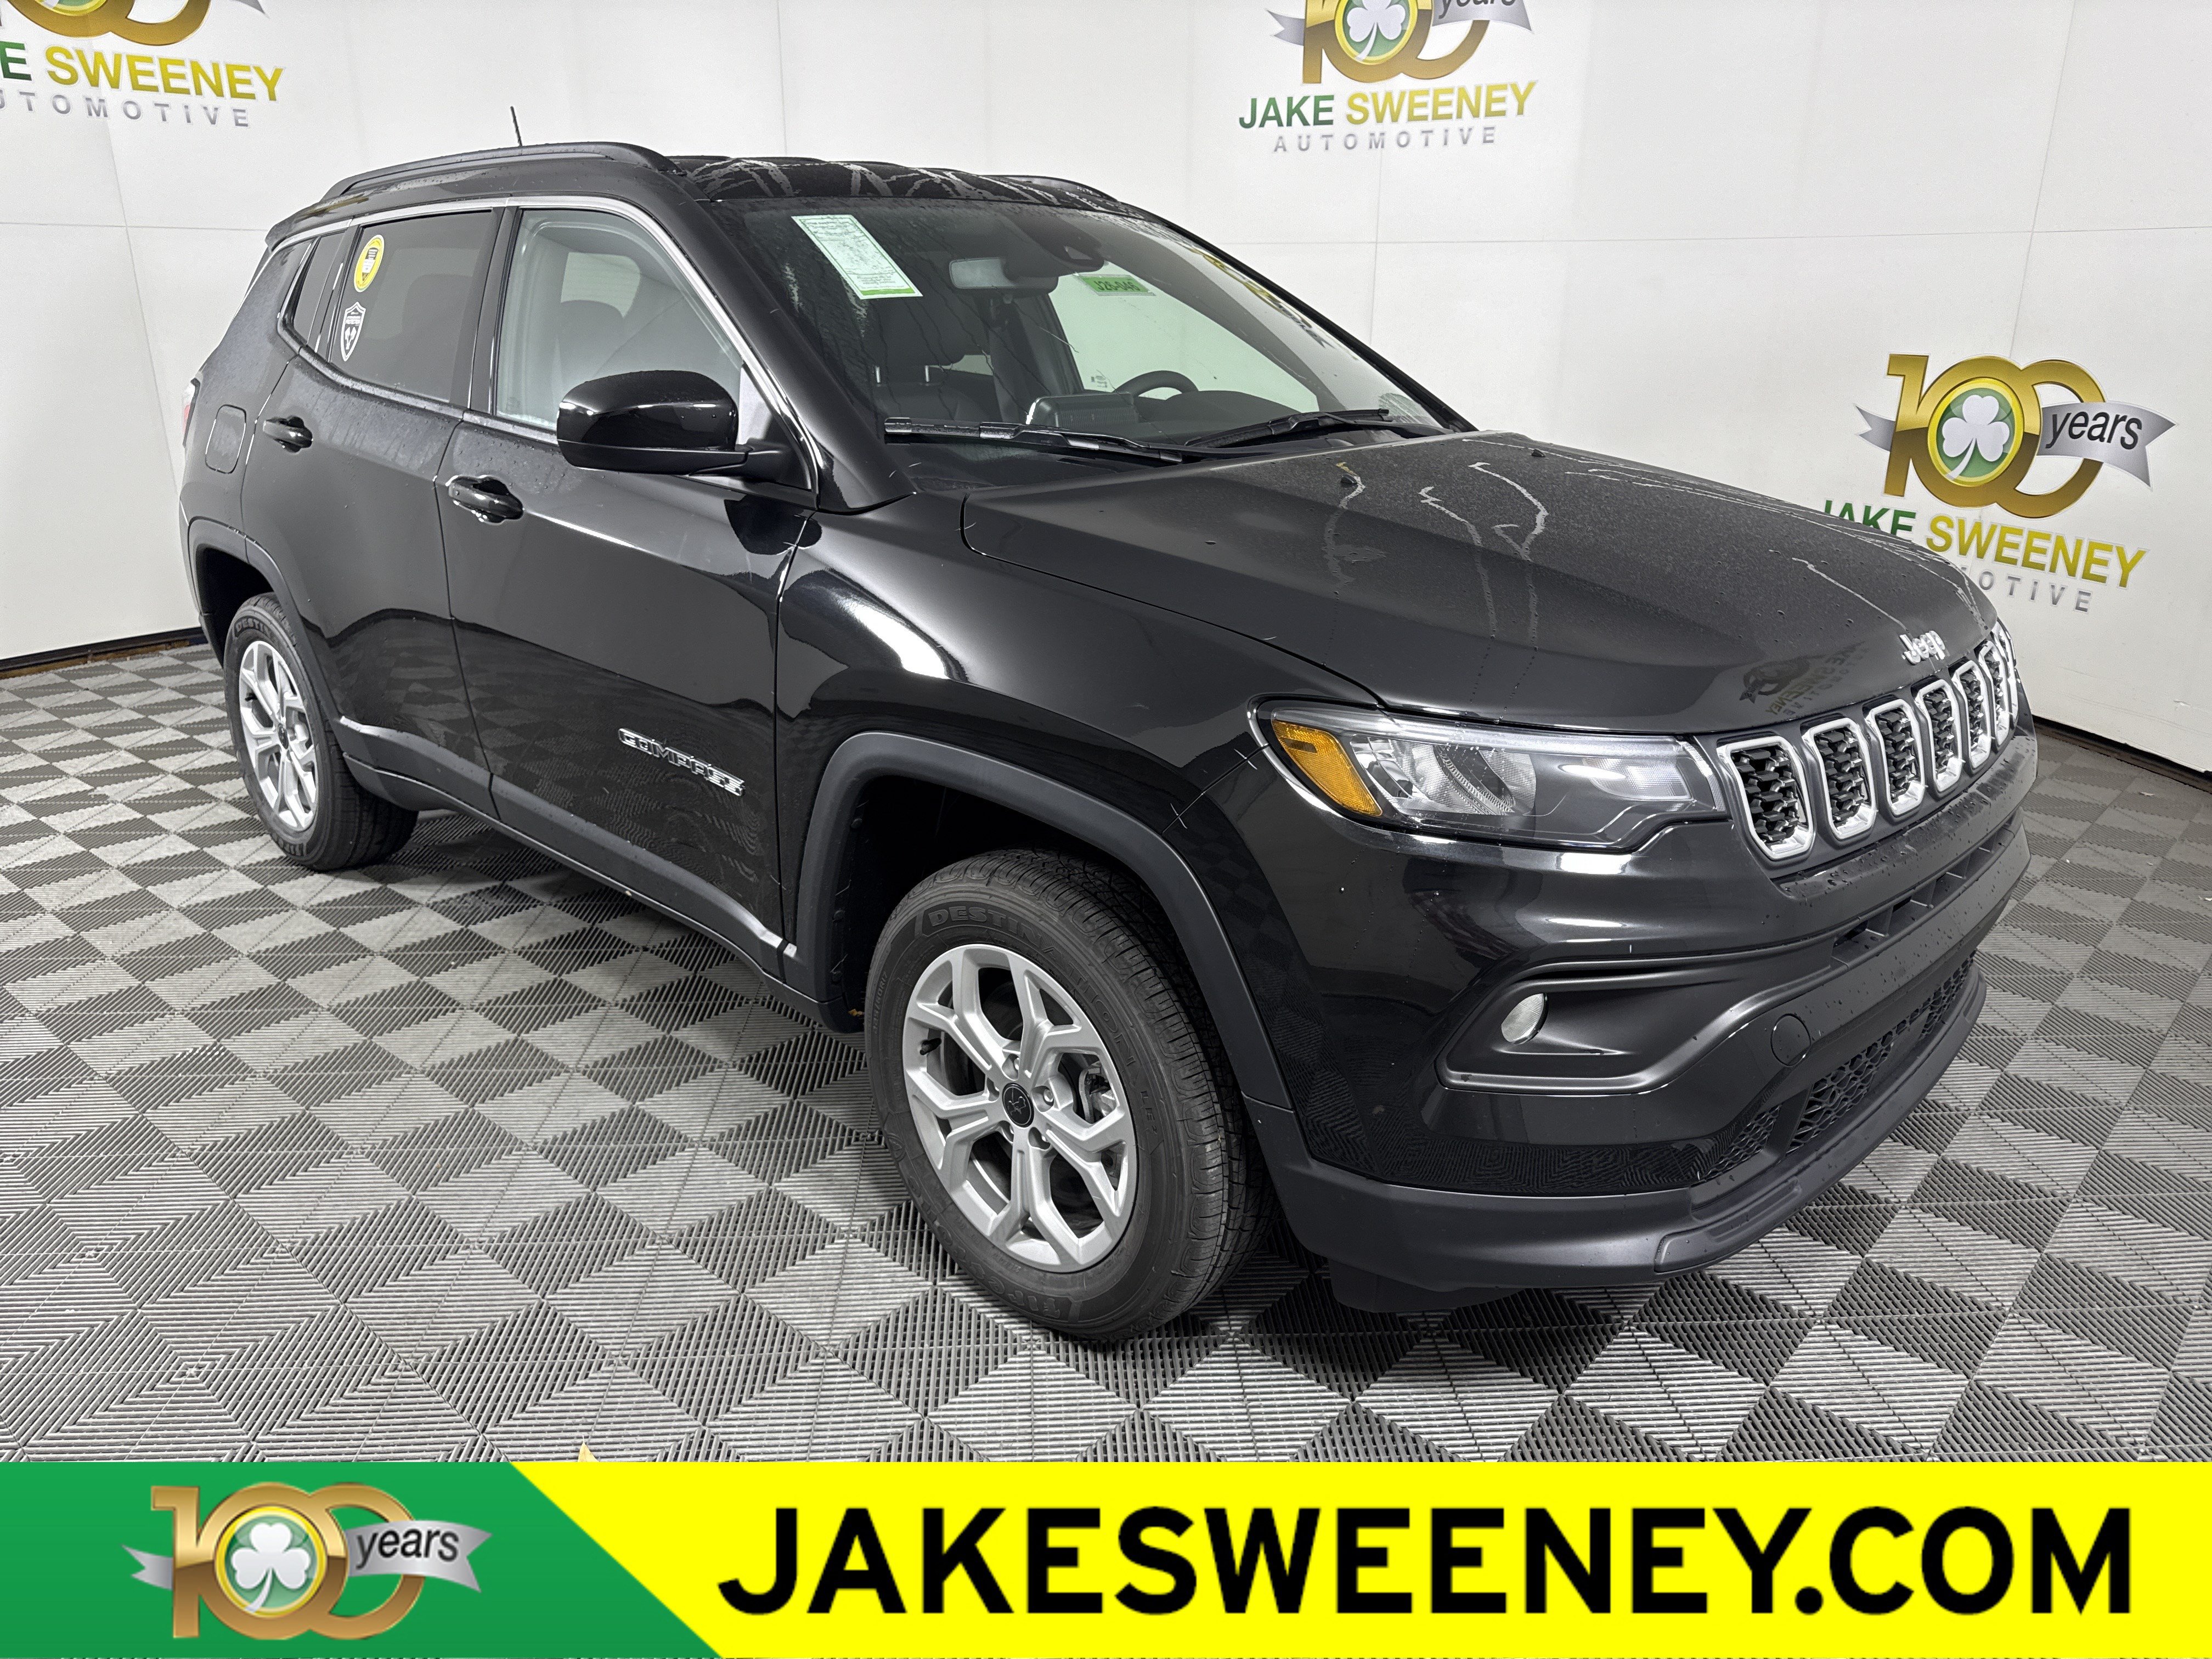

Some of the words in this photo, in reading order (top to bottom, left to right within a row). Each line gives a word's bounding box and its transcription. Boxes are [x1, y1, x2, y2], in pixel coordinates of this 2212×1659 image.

[45, 46, 284, 101] SWEENEY
[0, 89, 249, 127] TOMOTIVE
[1239, 94, 1335, 128] JAKE
[1346, 81, 1537, 125] SWEENEY
[1273, 126, 1496, 153] AUTOMOTIVE
[1883, 353, 2106, 519] 100
[2045, 411, 2142, 449] years
[1926, 515, 2146, 588] SWEENEY
[1899, 630, 1945, 663] Jeep
[618, 727, 746, 796] COMPASS
